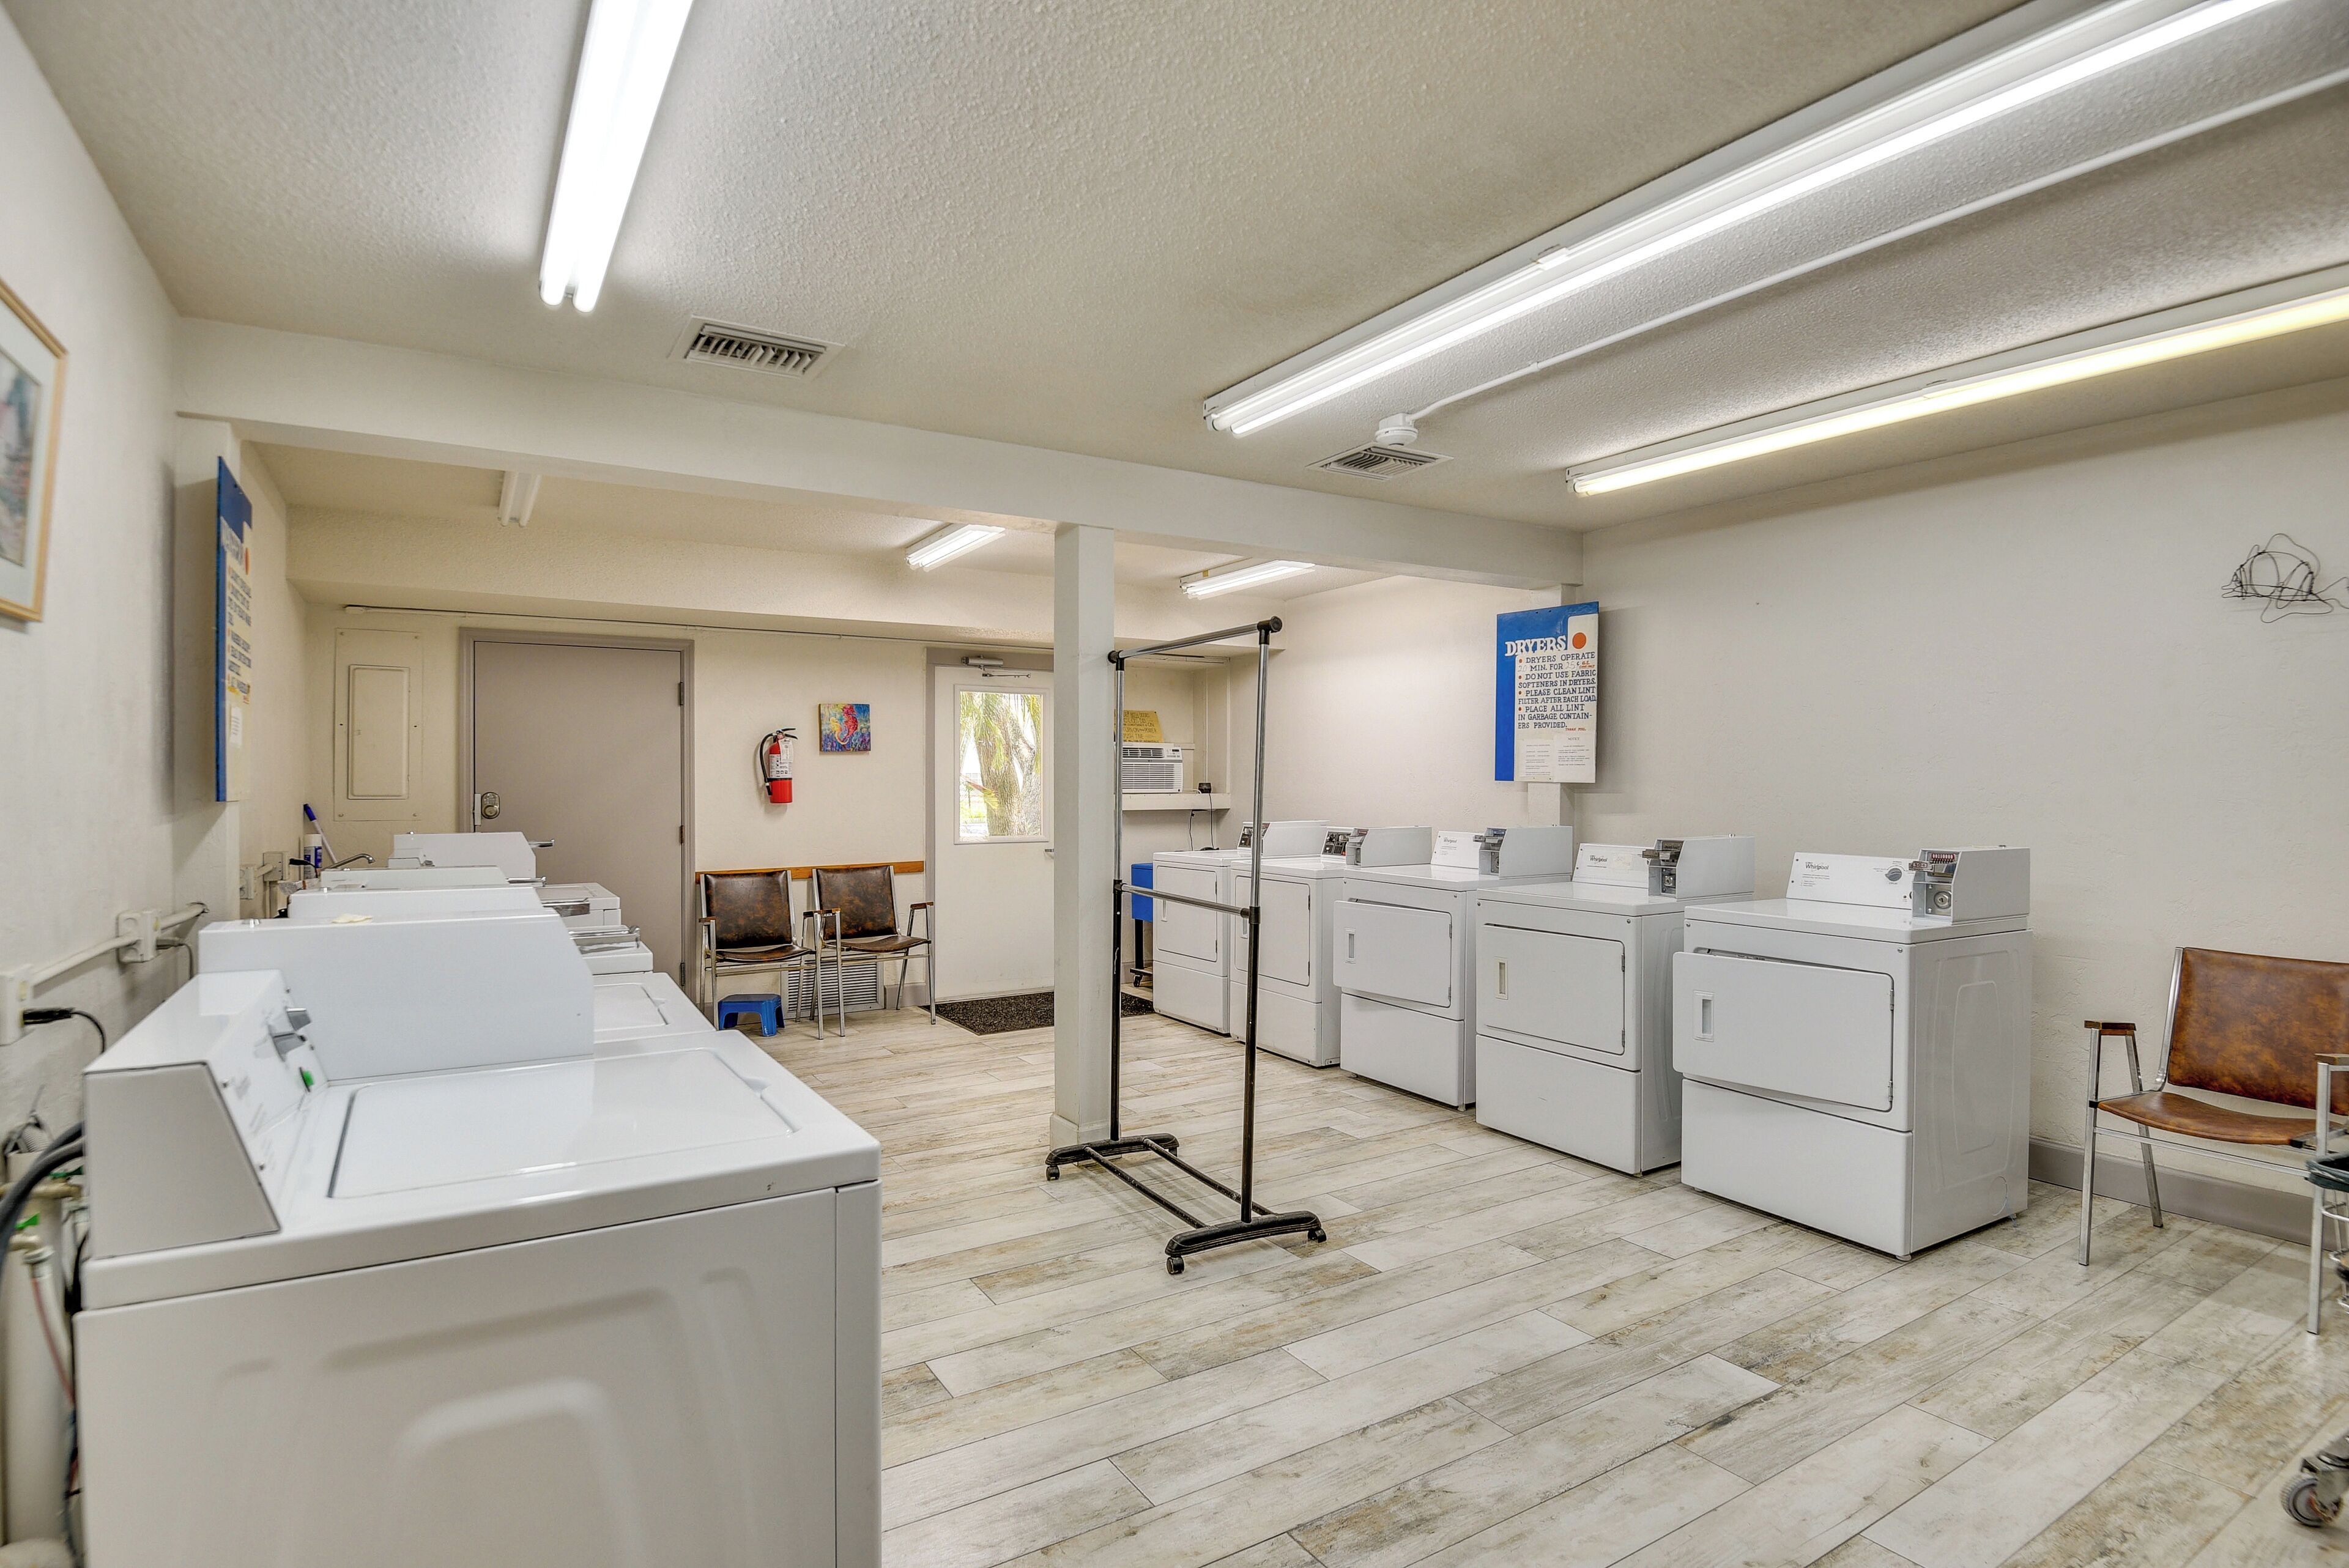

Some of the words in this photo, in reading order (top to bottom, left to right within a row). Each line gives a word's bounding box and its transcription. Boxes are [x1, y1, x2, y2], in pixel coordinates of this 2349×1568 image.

[1505, 635, 1567, 657] DRYERS
[1526, 655, 1556, 664] DRYERS
[1560, 652, 1595, 661] OPERATE
[1518, 680, 1558, 689] SOFTENERS
